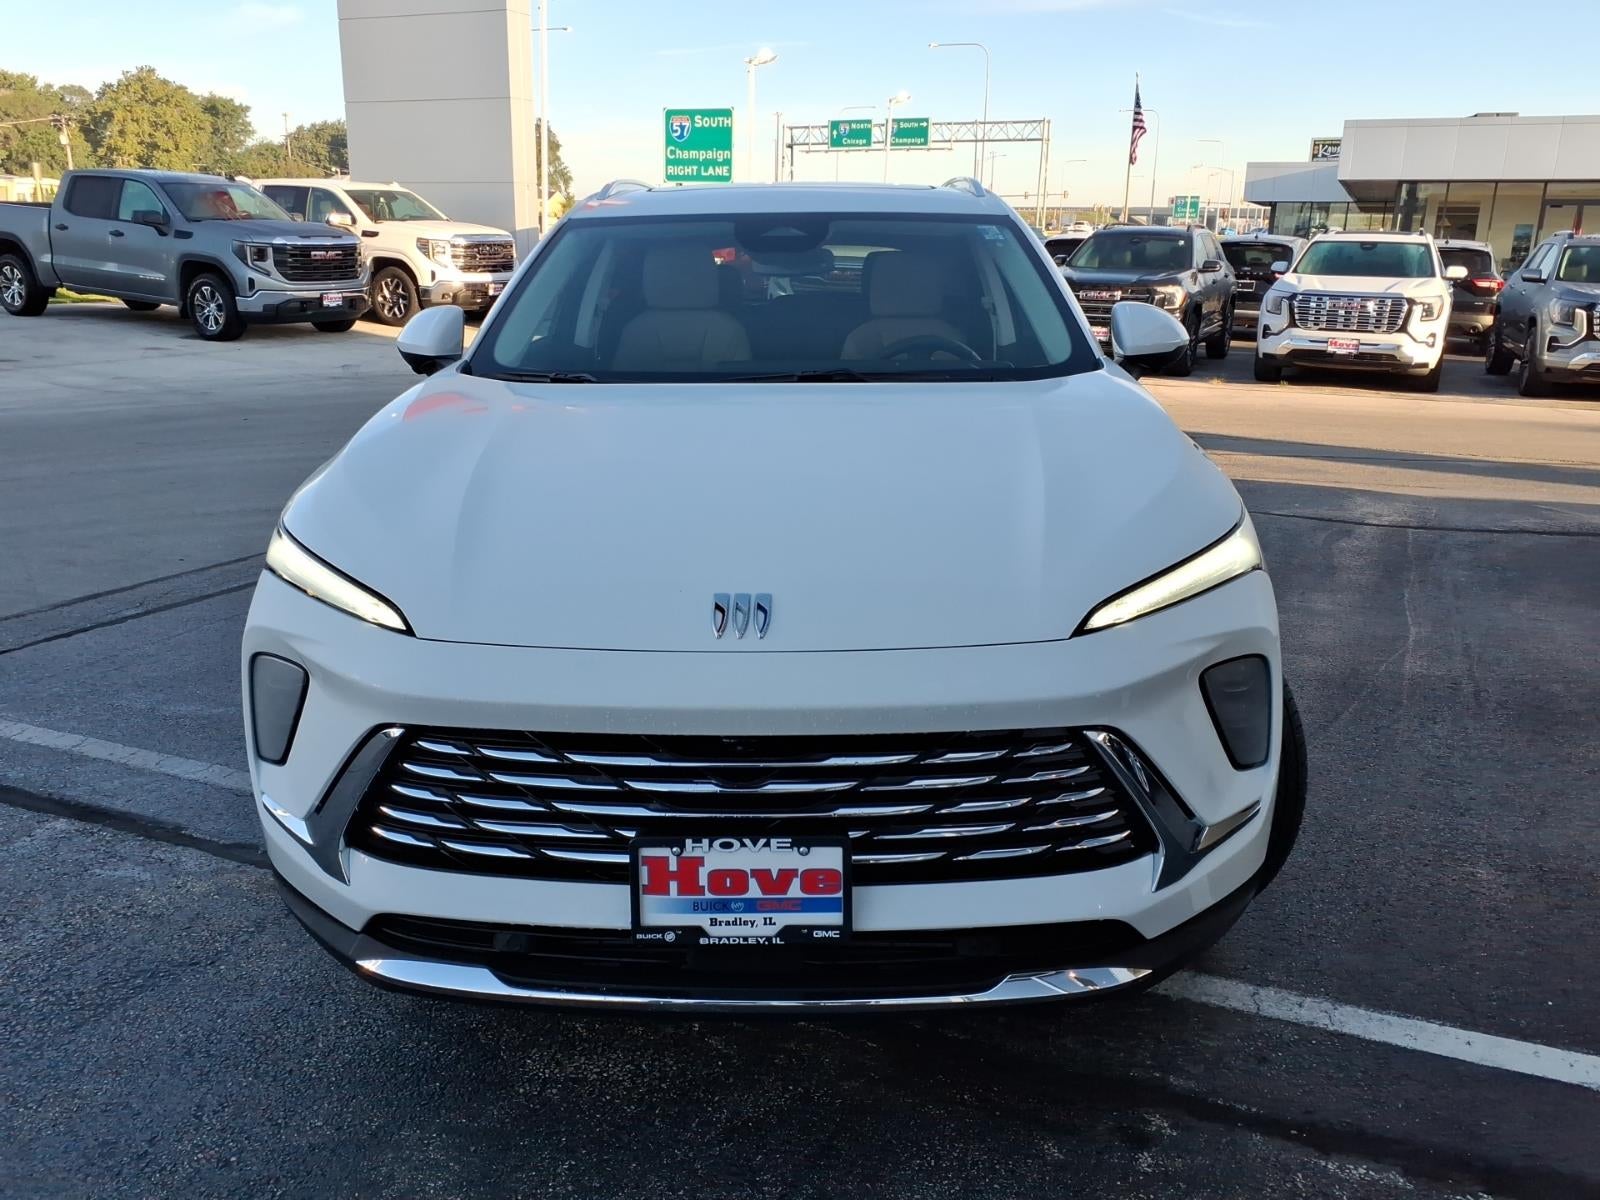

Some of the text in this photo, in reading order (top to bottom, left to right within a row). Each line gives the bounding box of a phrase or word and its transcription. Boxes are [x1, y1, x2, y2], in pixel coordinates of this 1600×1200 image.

[672, 122, 689, 137] 57
[666, 146, 731, 162] Champaign
[667, 165, 730, 176] RIGHT LANE
[685, 838, 793, 853] HOVE
[641, 856, 842, 896] Hove
[692, 899, 802, 912] BUICK GMC
[709, 917, 776, 928] Bradley, IL
[813, 930, 840, 938] GMC
[699, 937, 785, 945] BRADLEY, IL
